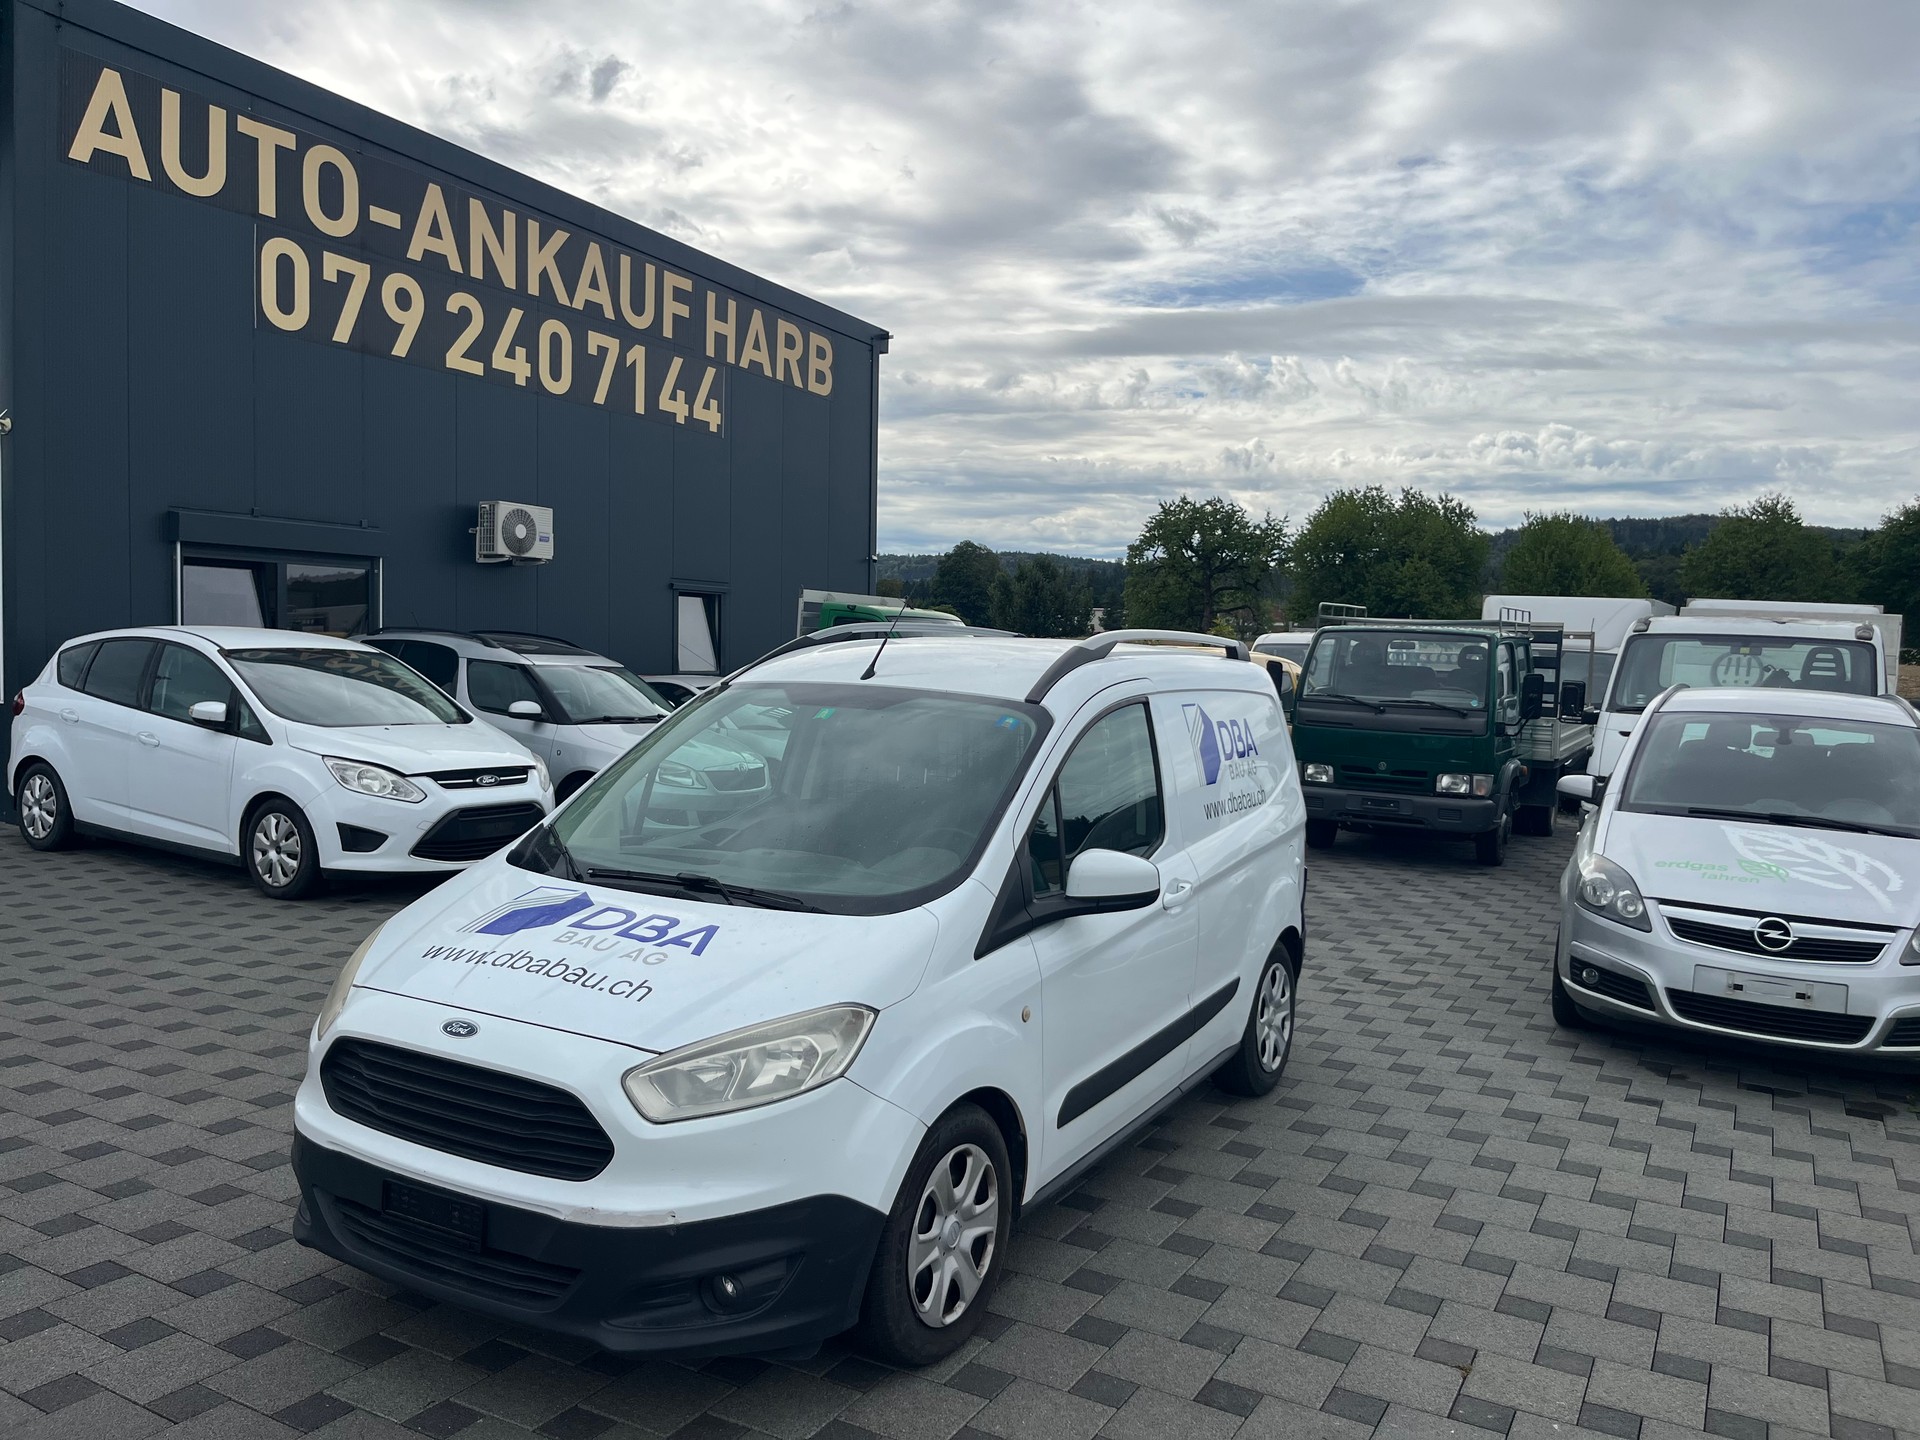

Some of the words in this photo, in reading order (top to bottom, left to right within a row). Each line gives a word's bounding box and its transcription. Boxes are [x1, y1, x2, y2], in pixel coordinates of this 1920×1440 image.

[68, 68, 693, 339] AUTO-ANKAUF
[706, 291, 834, 396] HARB
[260, 237, 425, 358] 079
[445, 291, 573, 395] 240
[1216, 718, 1258, 761] DBA
[1229, 762, 1246, 781] BAU
[1247, 760, 1257, 777] AG
[1203, 785, 1266, 820] www.dbabau.ch
[1654, 860, 1729, 872] erdgas
[1701, 871, 1760, 884] fahren
[552, 931, 619, 952] BAU
[624, 947, 669, 966] AG
[567, 906, 720, 957] DBA
[421, 944, 654, 1003] www.dbabau.ch
[445, 1020, 473, 1036] Ford
